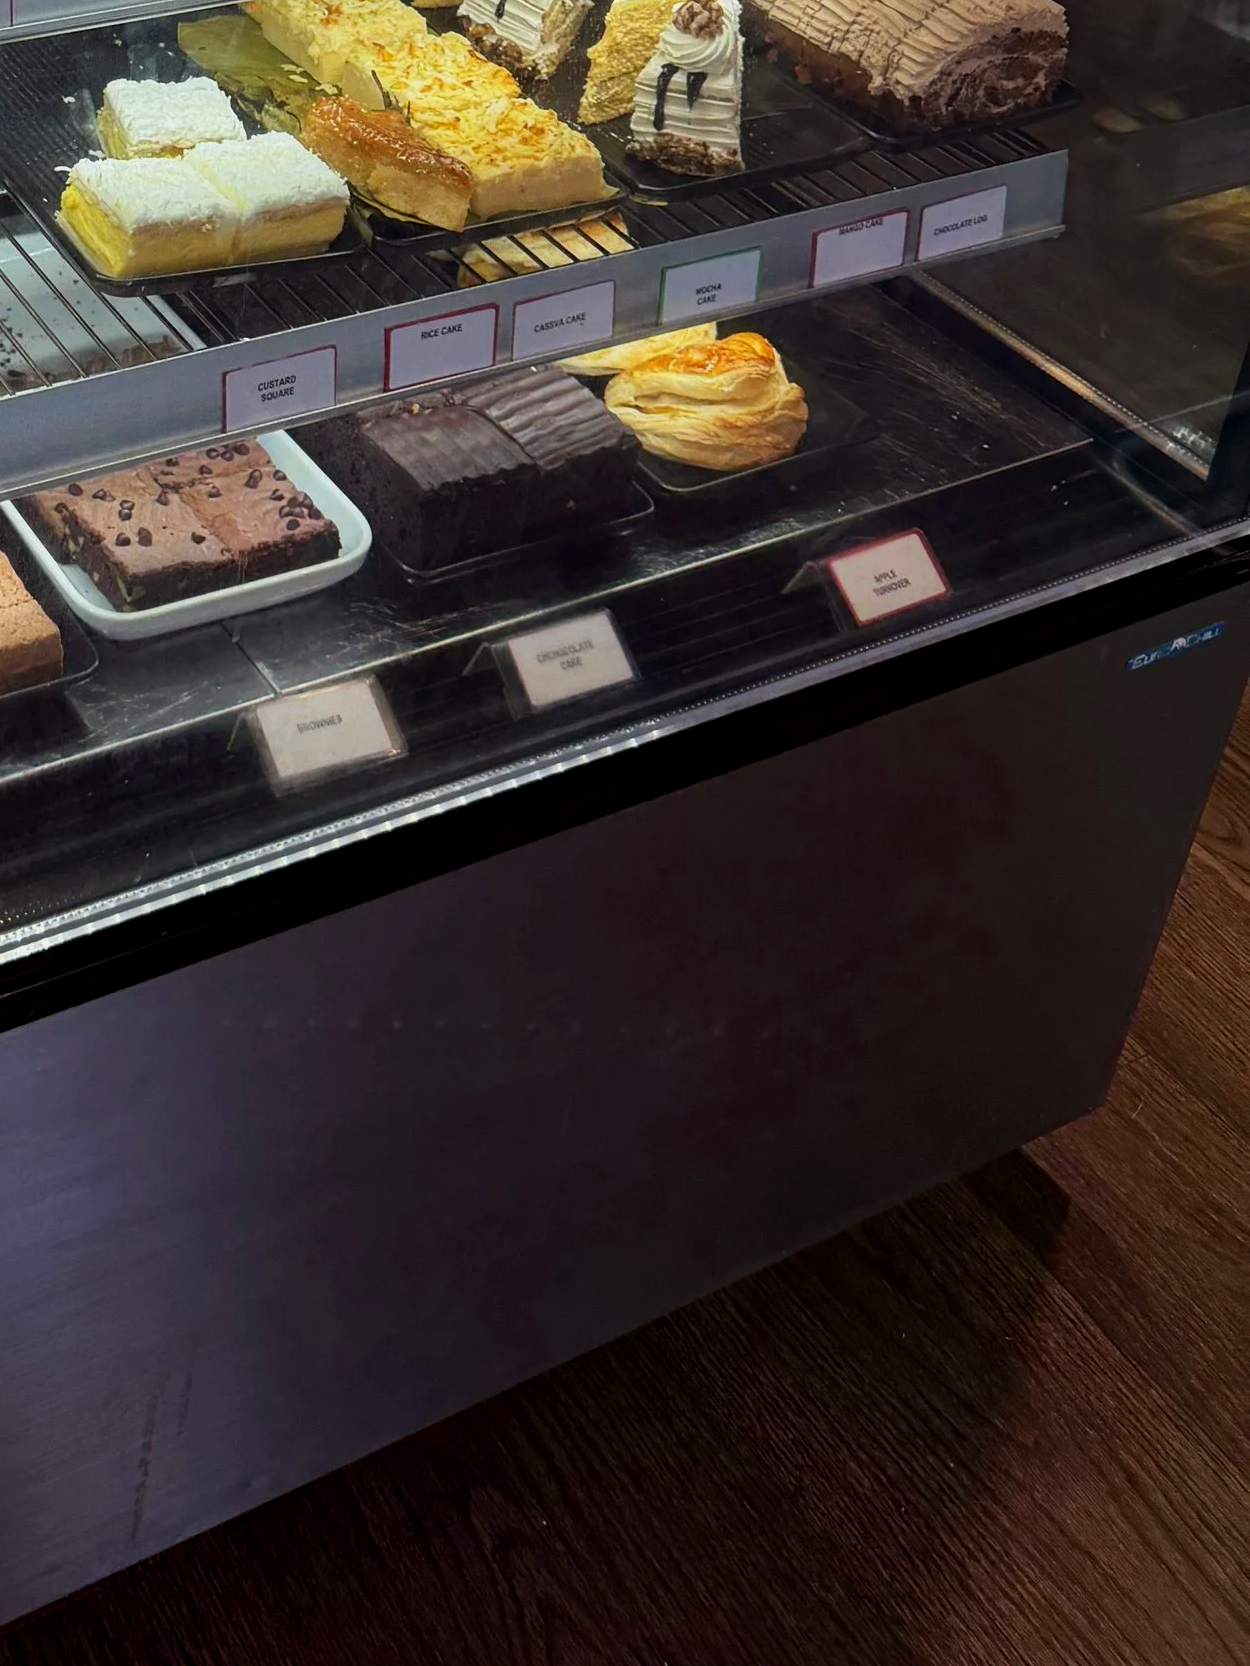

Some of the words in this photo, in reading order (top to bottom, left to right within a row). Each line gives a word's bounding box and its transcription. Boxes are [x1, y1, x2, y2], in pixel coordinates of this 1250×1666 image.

[933, 218, 973, 236] CHOCOLATE
[695, 283, 722, 295] MOCHA
[697, 294, 717, 306] CAKE
[533, 318, 564, 333] CASSVA
[565, 311, 587, 327] CAKE
[421, 326, 440, 340] RICE
[441, 322, 463, 336] CAKE
[257, 375, 297, 392] CUSTARD
[261, 386, 295, 403] SQUARE
